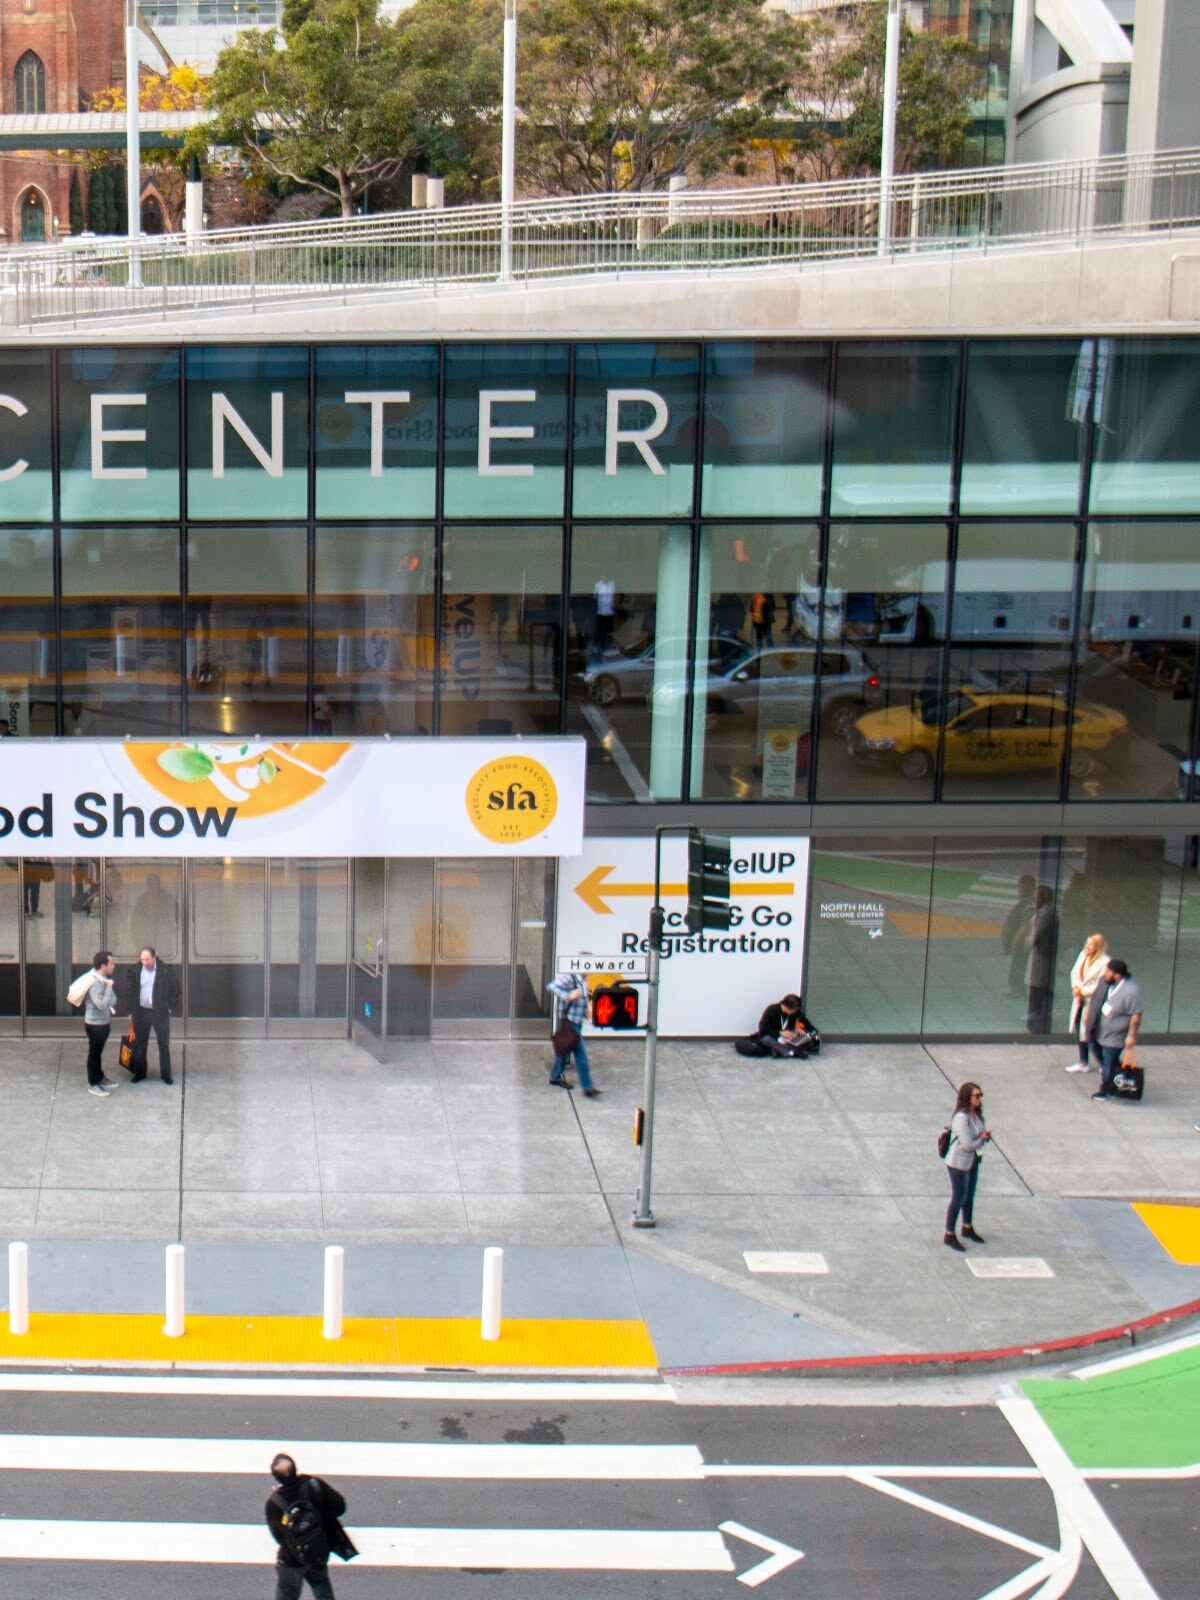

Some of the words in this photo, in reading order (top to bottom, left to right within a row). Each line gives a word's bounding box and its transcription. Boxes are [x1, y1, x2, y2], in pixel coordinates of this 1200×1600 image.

[487, 782, 538, 811] sfa
[73, 792, 238, 839] Show
[751, 905, 792, 927] Go
[820, 903, 856, 911] NORTH
[858, 903, 884, 911] HALL
[570, 959, 635, 970] Howard
